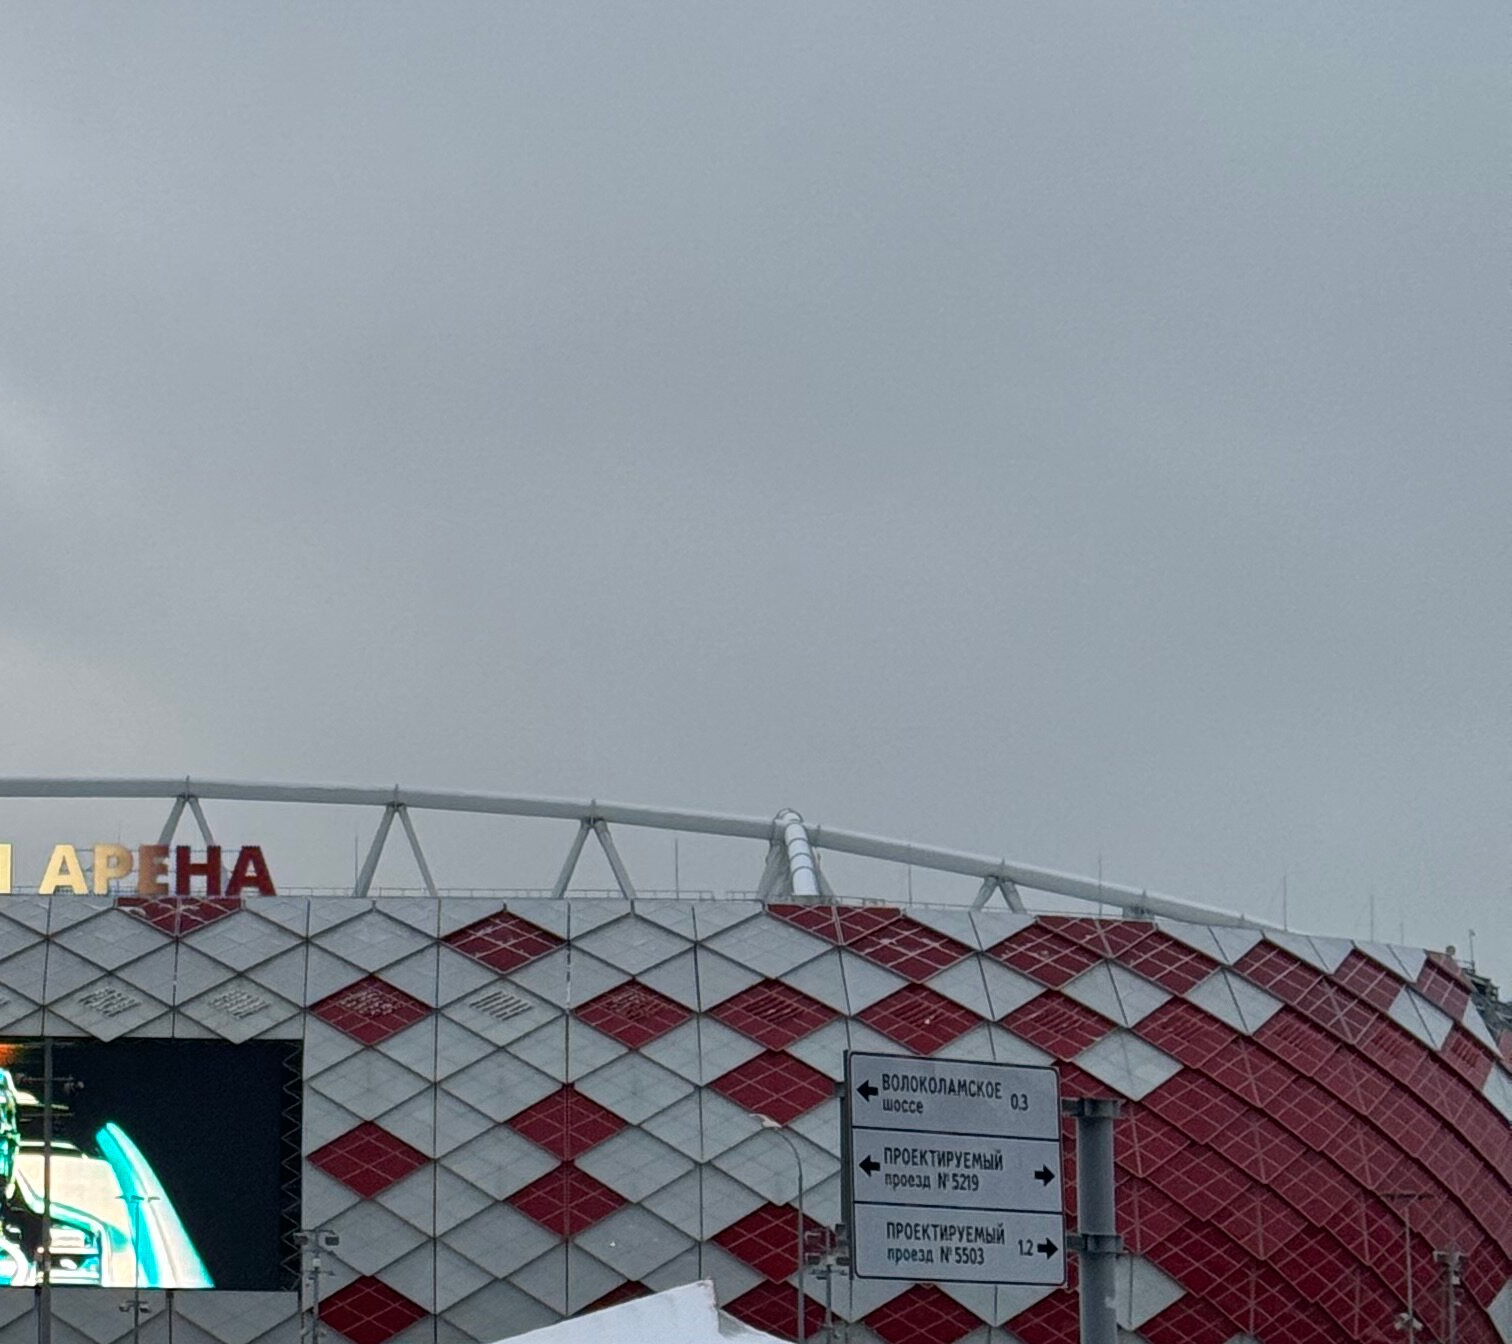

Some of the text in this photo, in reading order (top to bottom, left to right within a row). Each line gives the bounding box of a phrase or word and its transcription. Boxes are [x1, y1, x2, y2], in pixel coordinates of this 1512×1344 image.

[38, 843, 277, 897] АРЕНА
[882, 1073, 1002, 1100] ВОЛОКОЛАМСКОЕ
[882, 1100, 924, 1115] шоссе
[1010, 1093, 1029, 1112] 0.3
[883, 1147, 1004, 1171] ПРОЕКТИРУЕМЫЙ
[884, 1173, 931, 1191] проезд
[886, 1221, 1005, 1245] ПРОЕКТИРУЕМЫЙ
[887, 1247, 933, 1265] проезд
